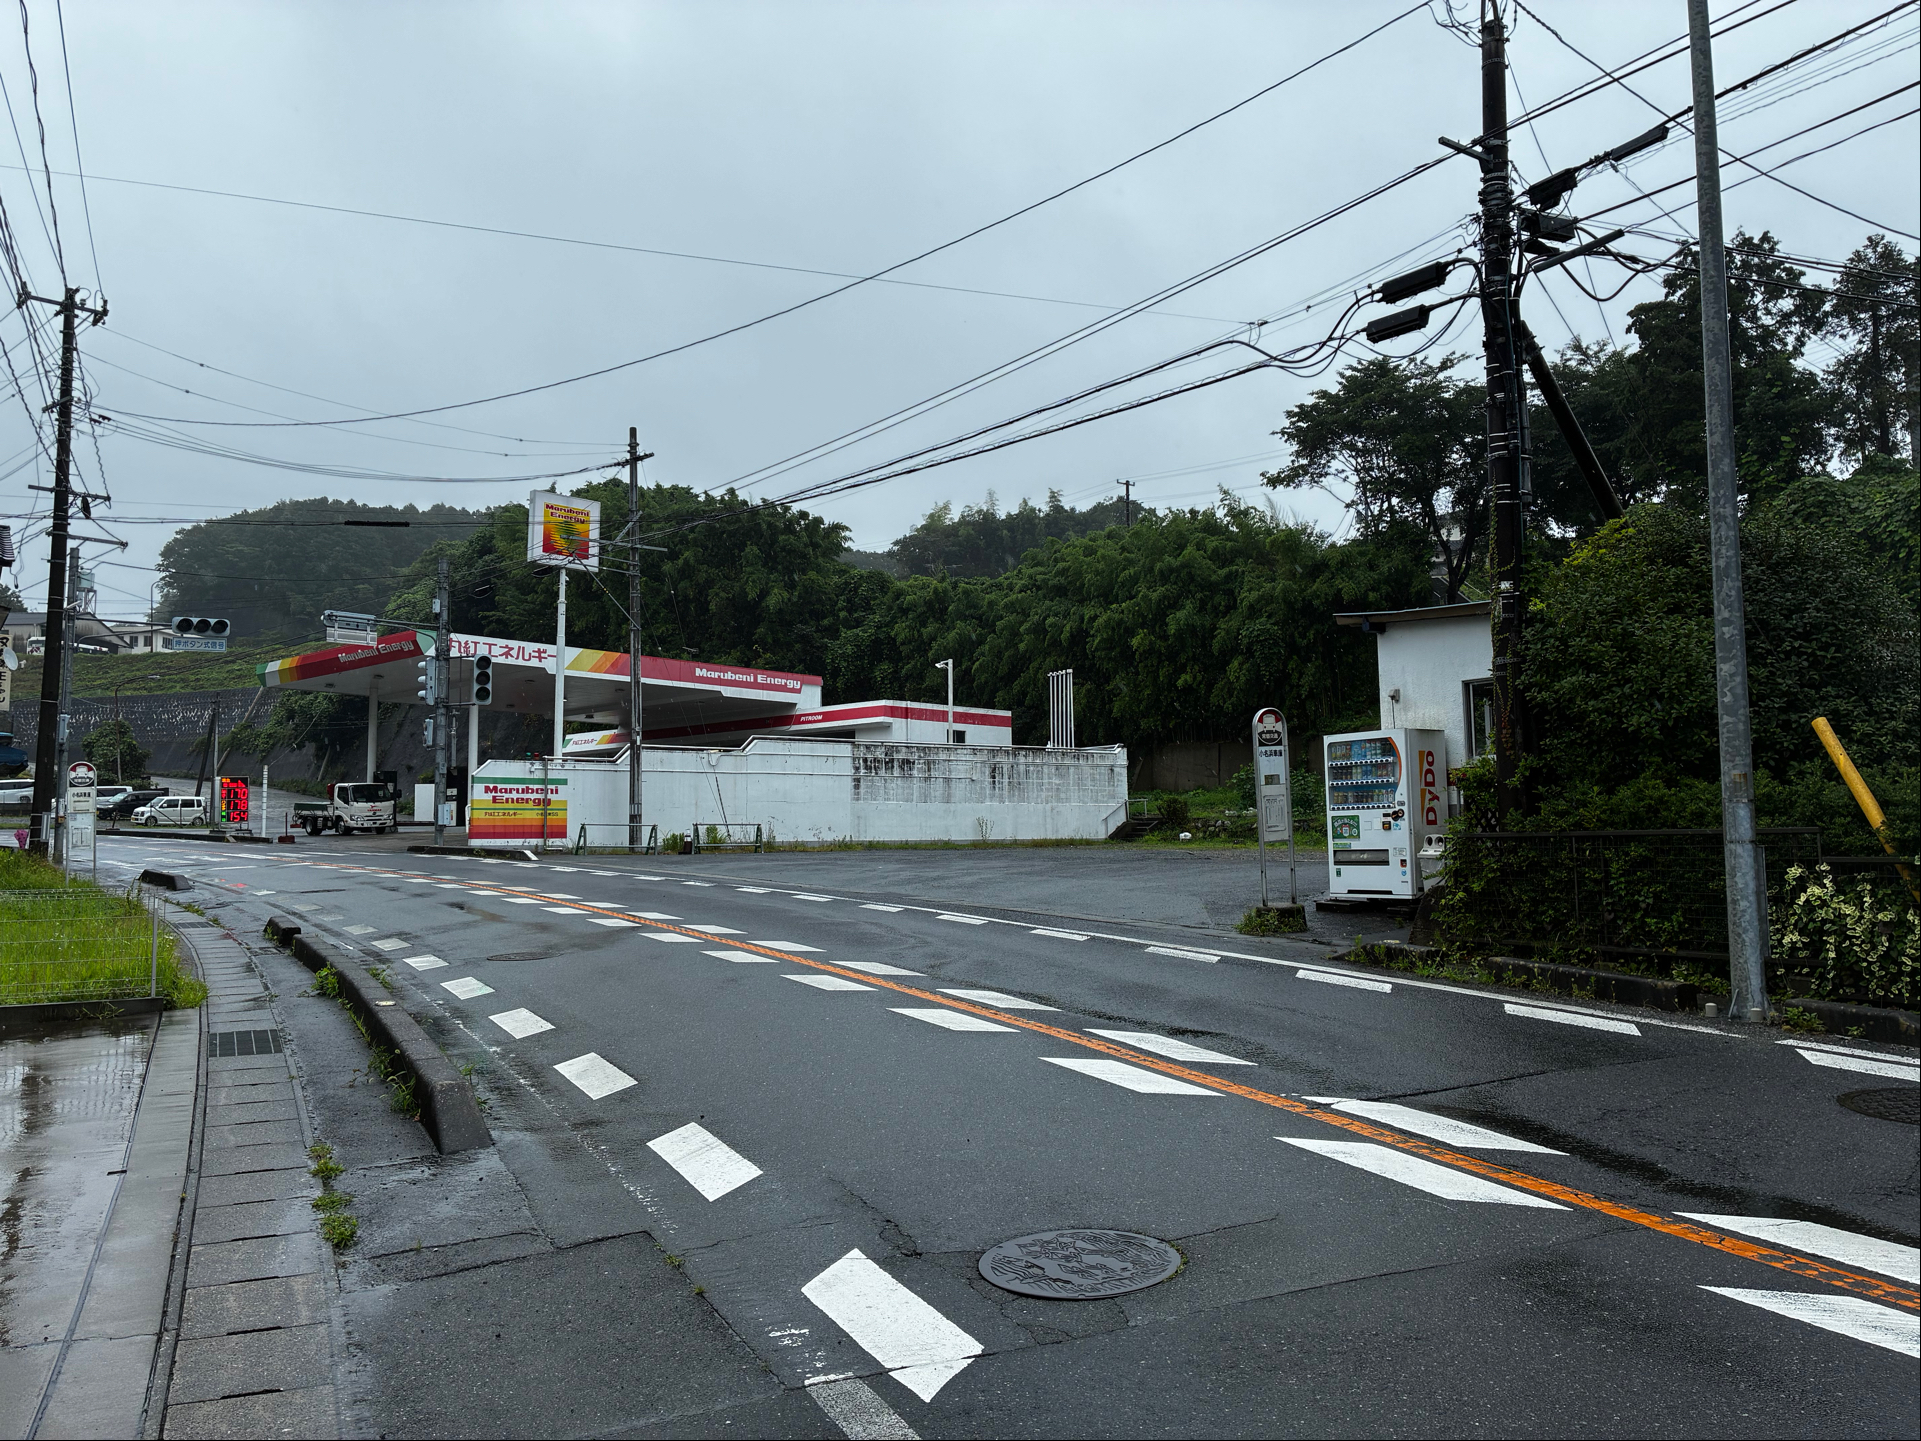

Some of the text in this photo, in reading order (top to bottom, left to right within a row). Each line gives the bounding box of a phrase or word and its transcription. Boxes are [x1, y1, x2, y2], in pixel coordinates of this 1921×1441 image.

[545, 503, 589, 517] Marubeni
[550, 511, 586, 524] Energy
[174, 639, 225, 650] 押ボタン式信号
[449, 637, 557, 663] 丸紅エネルギー
[337, 640, 415, 663] Marubeni Energy
[695, 667, 801, 689] Marubeni Energy
[800, 714, 823, 722] PITROOM
[230, 788, 248, 799] 170
[484, 785, 559, 795] Marubeni
[230, 799, 248, 810] 178
[491, 795, 552, 807] Energy
[230, 811, 248, 822] 154
